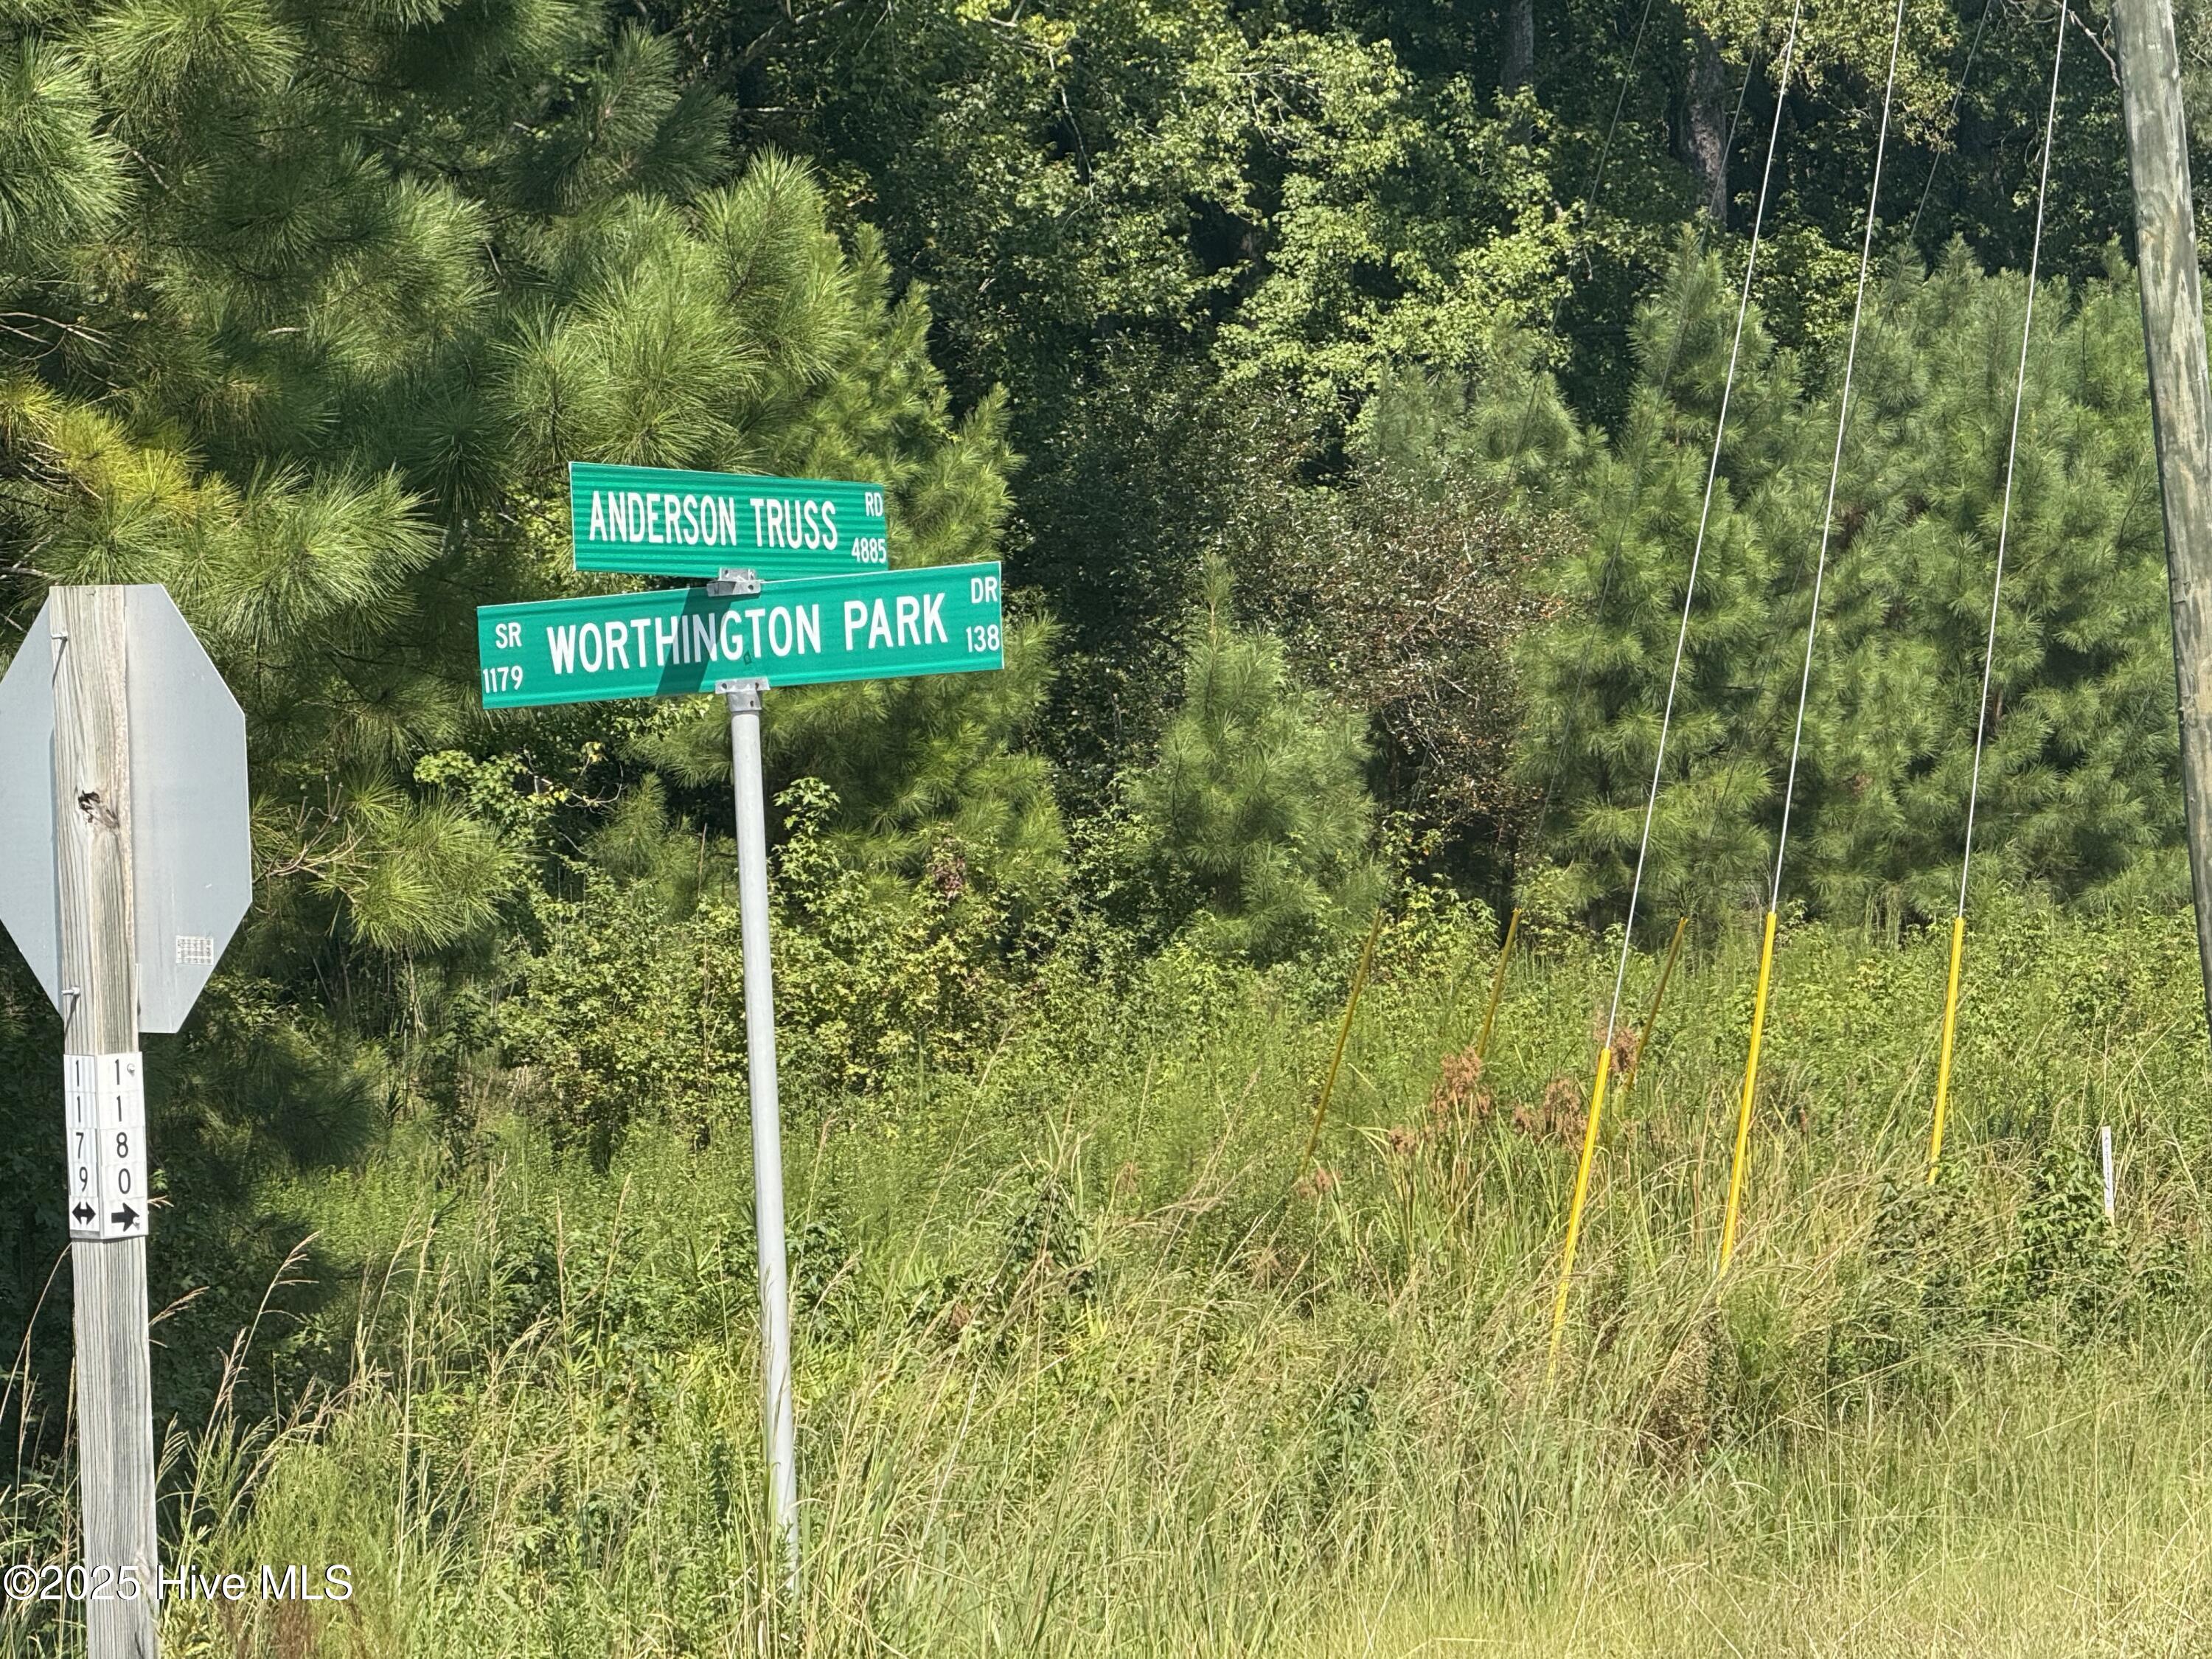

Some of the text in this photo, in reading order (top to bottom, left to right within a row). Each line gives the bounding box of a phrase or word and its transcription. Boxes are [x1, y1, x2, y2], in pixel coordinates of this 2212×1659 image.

[865, 492, 883, 517] RD
[589, 490, 839, 550] ANDERSON TRUSS
[851, 538, 887, 564] 4885
[970, 577, 998, 604] DR
[495, 622, 522, 649] SR
[546, 592, 948, 675] WORTHINGTON PARK
[966, 625, 1001, 653] 138
[483, 665, 524, 693] 1179
